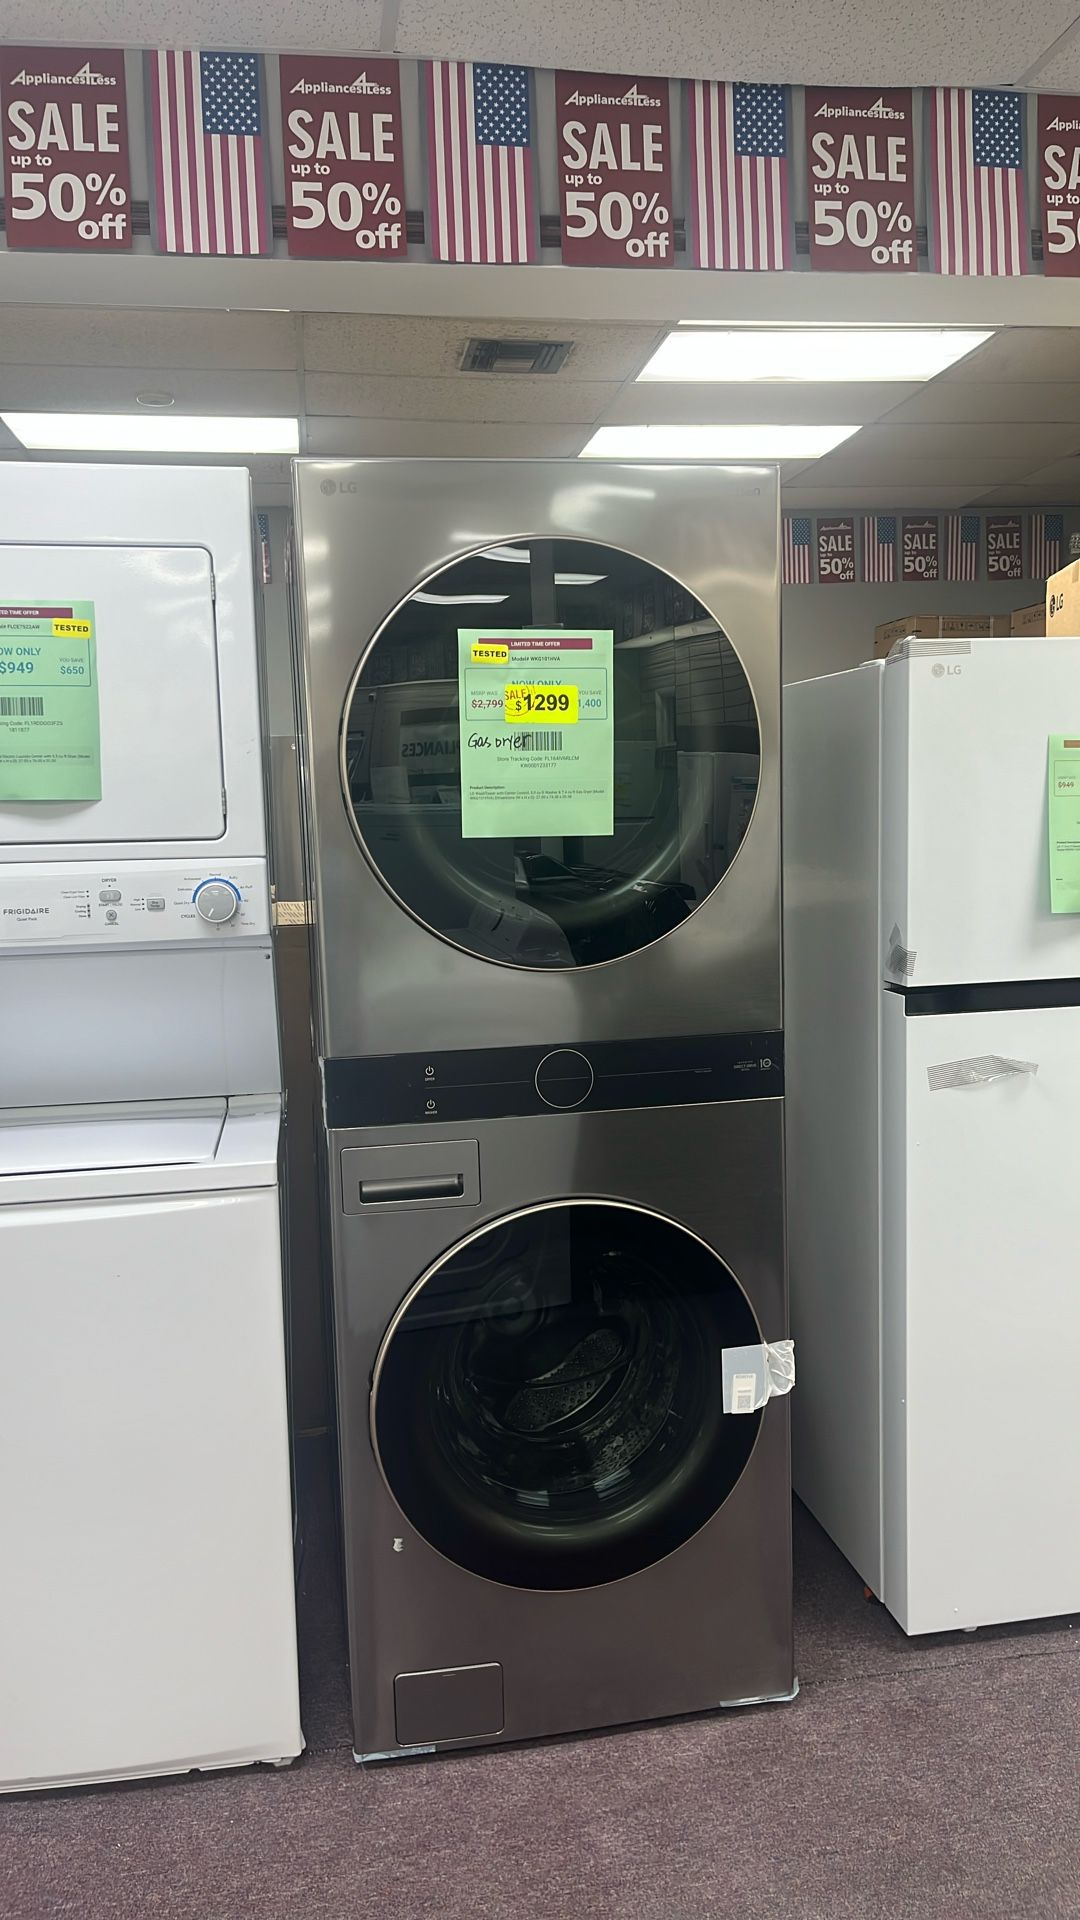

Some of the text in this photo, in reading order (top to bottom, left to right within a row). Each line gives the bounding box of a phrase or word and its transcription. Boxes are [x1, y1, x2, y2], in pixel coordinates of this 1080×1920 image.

[8, 101, 119, 152] SALE
[1046, 116, 1080, 132] Appli
[287, 110, 395, 162] SALE
[562, 121, 663, 172] SALE
[11, 155, 52, 170] up to
[812, 132, 906, 182] SALE
[291, 164, 330, 177] up to
[566, 174, 602, 188] up to
[11, 173, 126, 221] 50%
[814, 183, 849, 196] up to
[291, 182, 401, 231] 50%
[1047, 193, 1080, 206] up to
[565, 192, 669, 240] 50%
[814, 201, 912, 247] 50%
[78, 213, 126, 241] off
[1047, 210, 1080, 254] 5
[355, 221, 401, 250] off
[626, 232, 670, 258] off
[871, 240, 912, 266] off
[340, 481, 358, 494] LG
[819, 535, 852, 552] SALE
[904, 534, 936, 550] SALE
[988, 533, 1020, 549] SALE
[820, 556, 854, 574] 50%
[904, 555, 938, 573] 50%
[988, 554, 1021, 572] 50%
[840, 570, 854, 580] off
[923, 568, 937, 578] off
[1008, 567, 1021, 577] off
[54, 624, 89, 632] TESTED
[16, 647, 41, 656] ONLY
[473, 650, 507, 658] TESTED
[0, 661, 34, 674] $949
[60, 666, 85, 674] $650
[947, 665, 962, 675] LG
[505, 688, 526, 700] SALE
[471, 699, 504, 709] $2,799
[468, 733, 491, 749] Gas
